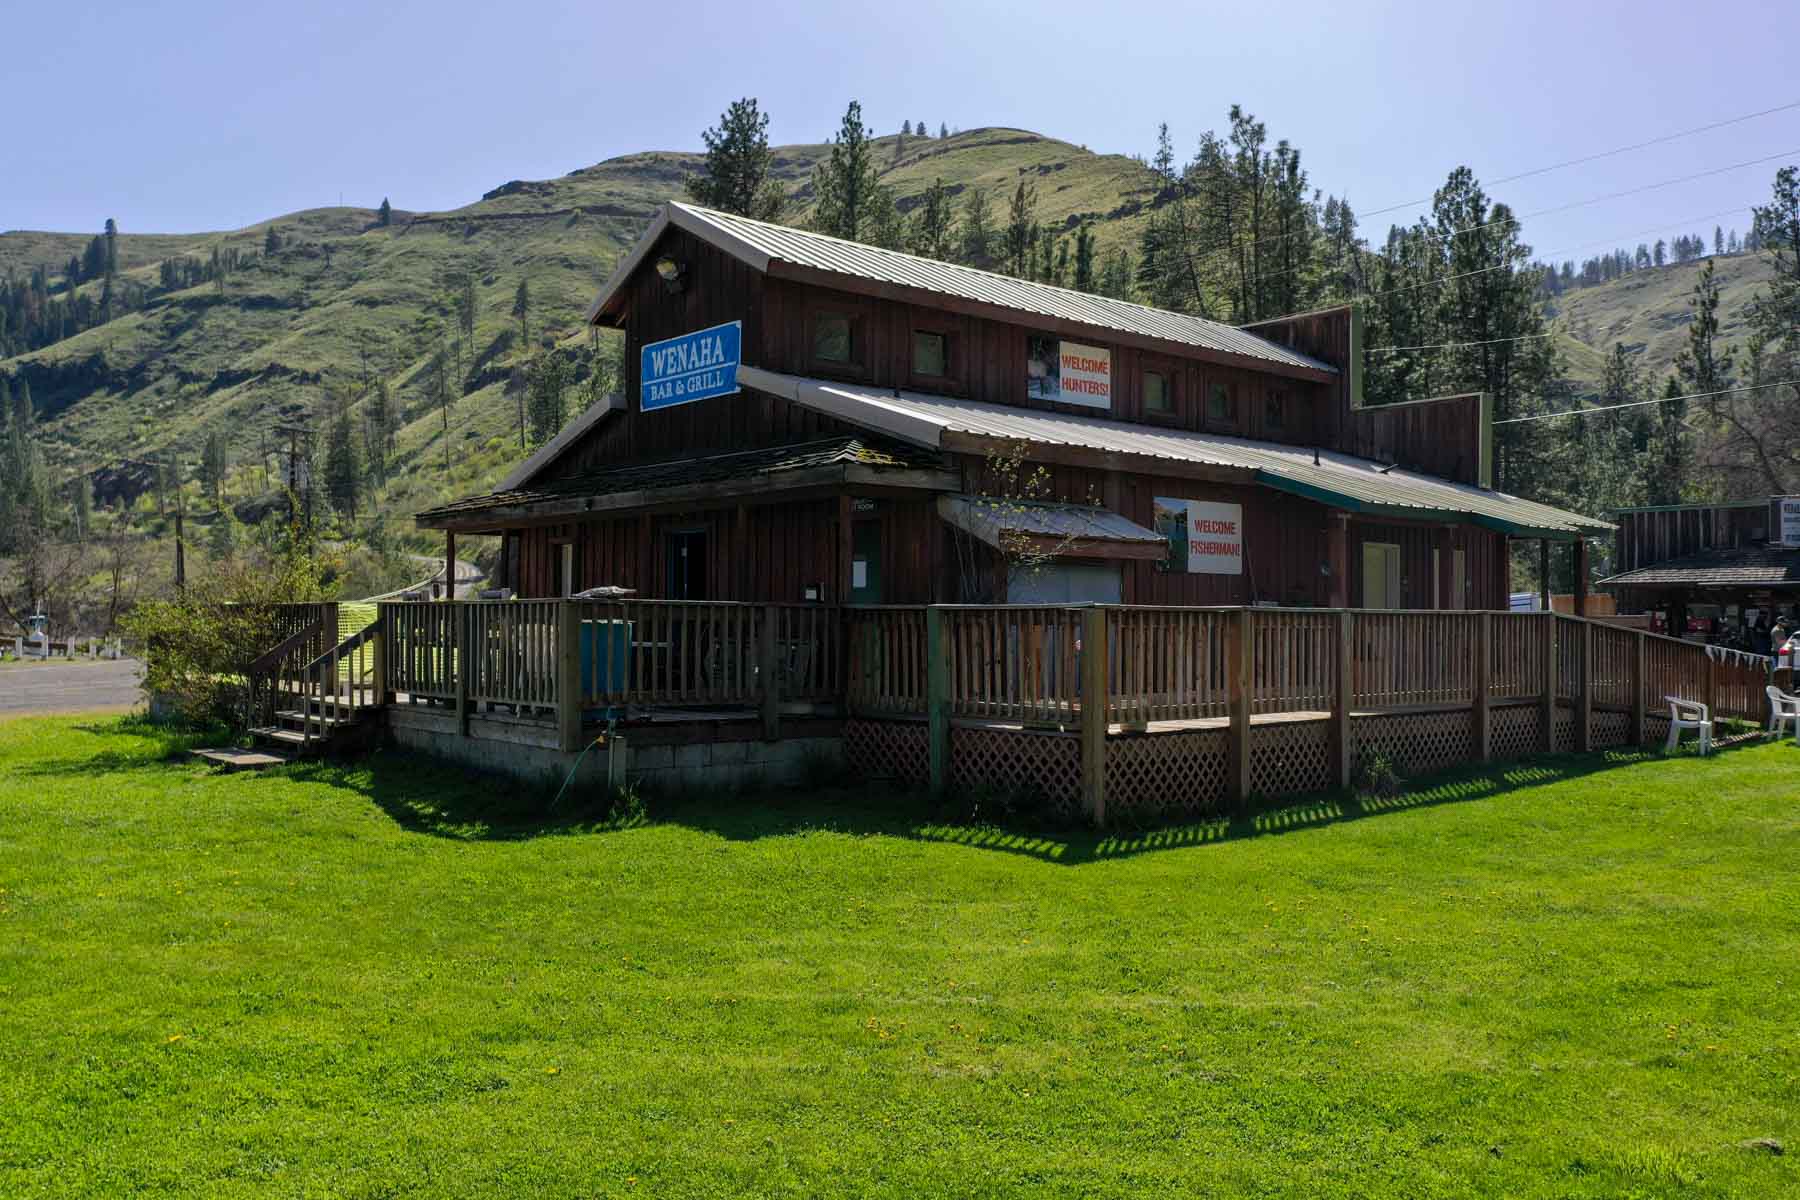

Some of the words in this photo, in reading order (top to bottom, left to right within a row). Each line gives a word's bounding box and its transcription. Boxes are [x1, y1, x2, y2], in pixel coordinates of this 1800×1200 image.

[652, 336, 725, 377] WENAHA
[1061, 352, 1109, 375] WELCOME
[651, 382, 673, 400] BAR
[676, 381, 685, 394] &
[687, 371, 724, 393] GRILL
[1061, 377, 1109, 396] HUNTERS!
[1194, 519, 1236, 535] WELCOME
[1190, 540, 1240, 557] FISHERMAN!
